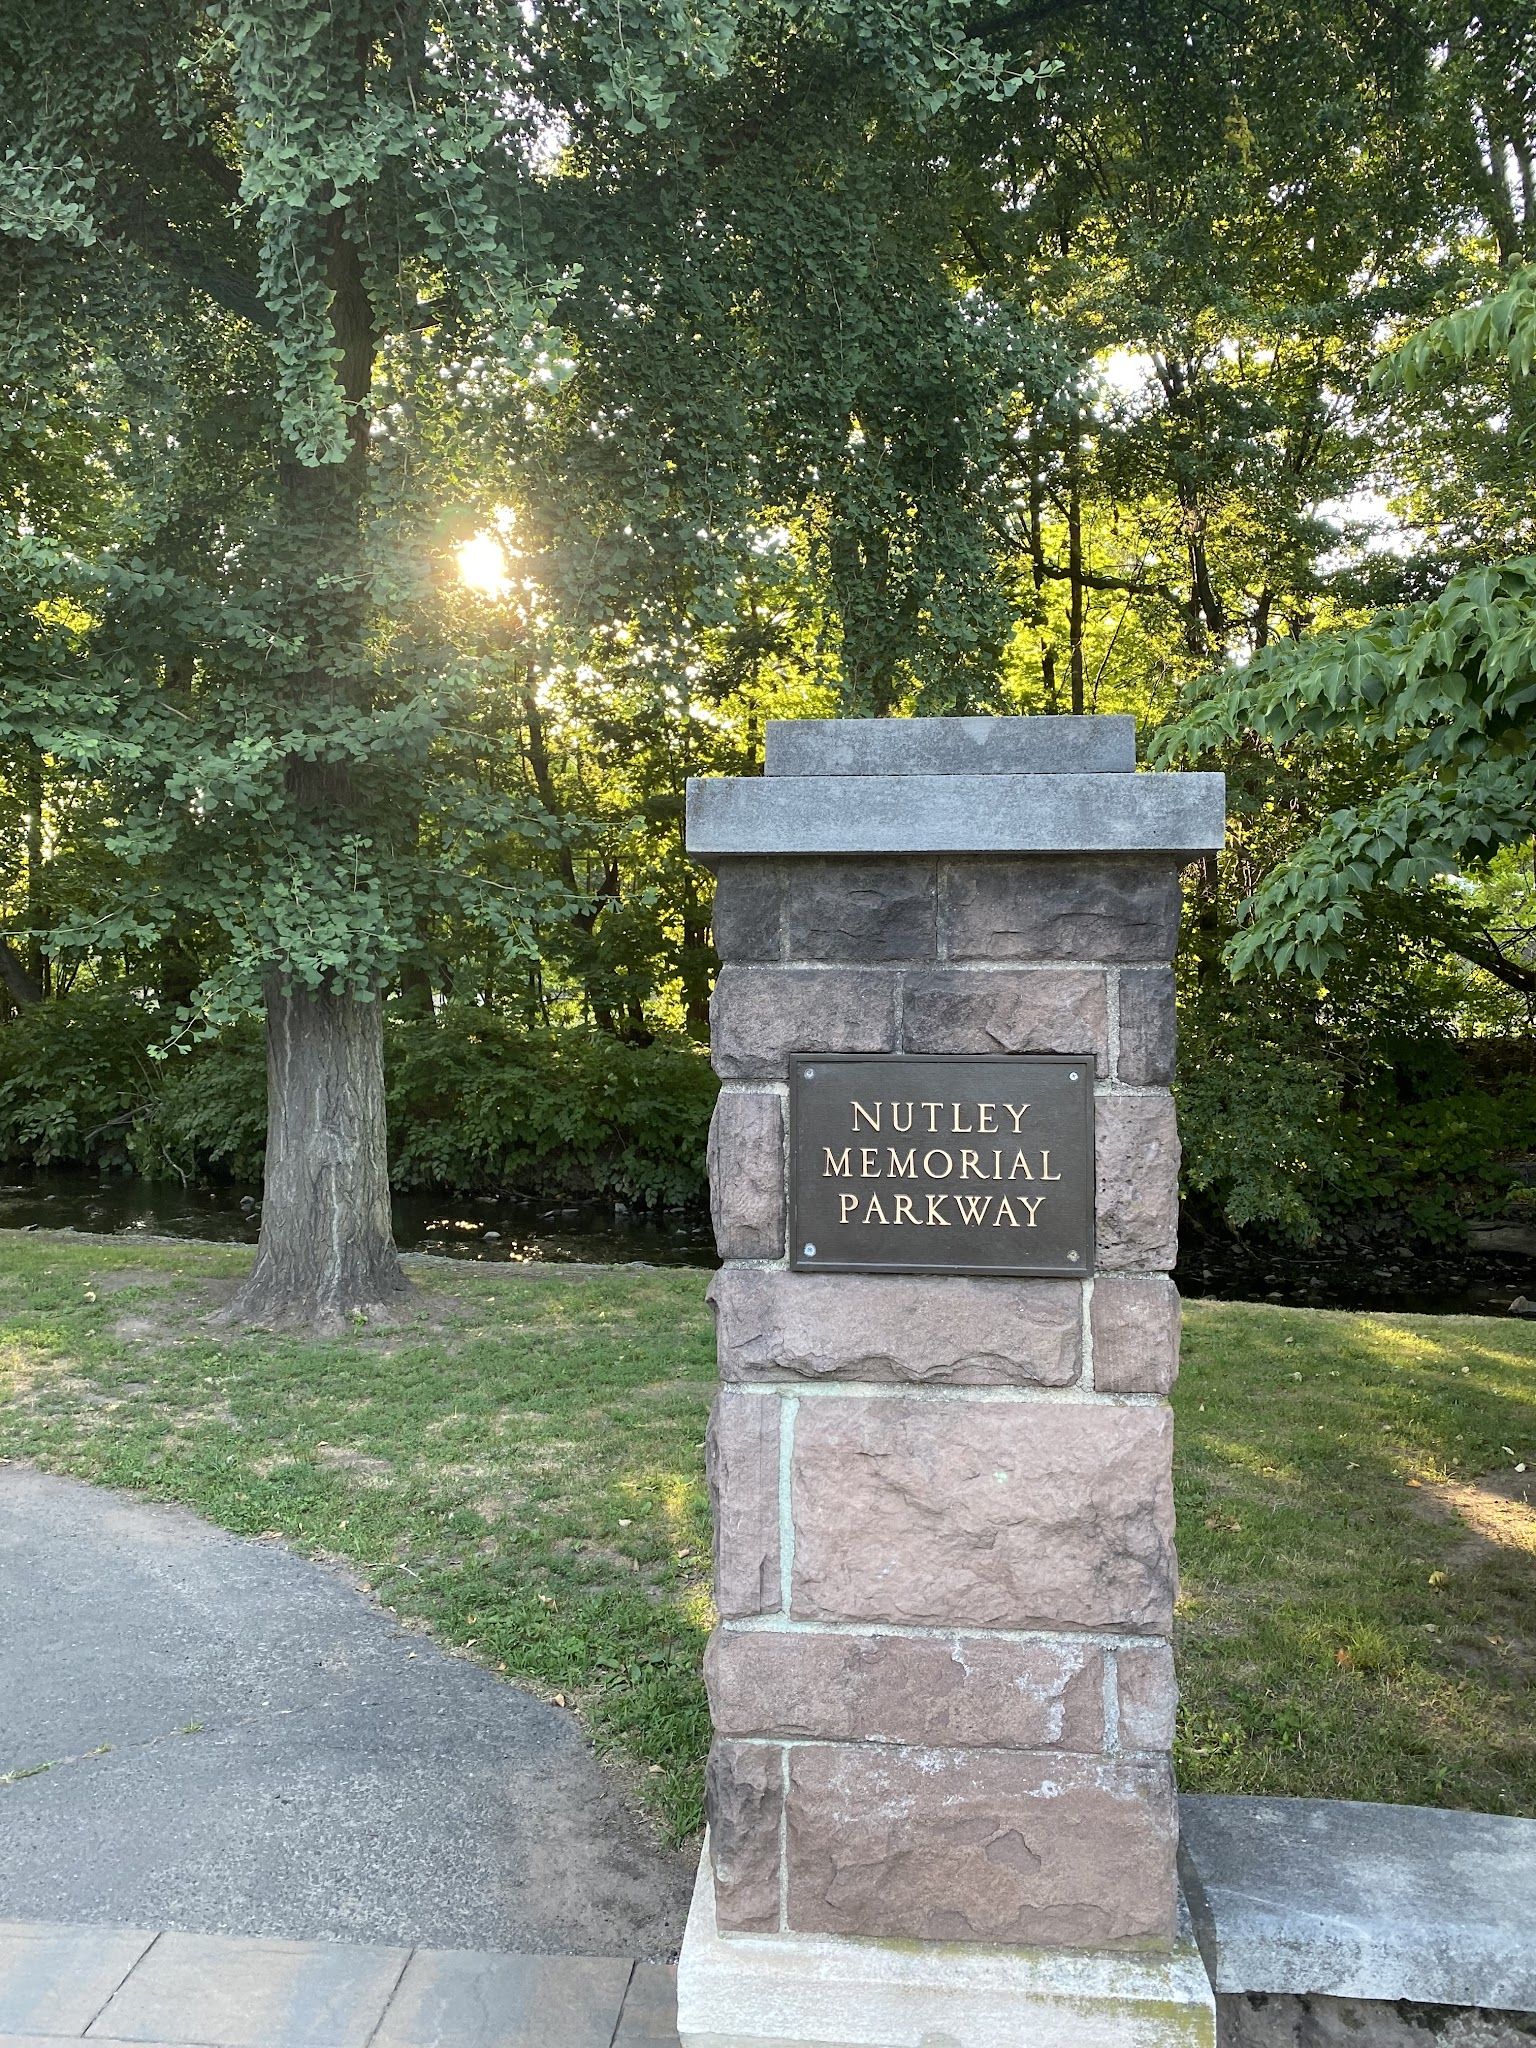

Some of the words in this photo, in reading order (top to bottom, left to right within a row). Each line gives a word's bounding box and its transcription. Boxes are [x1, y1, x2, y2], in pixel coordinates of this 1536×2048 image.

[849, 1100, 1032, 1133] NUTLEY
[821, 1146, 1062, 1181] MEMORIAL
[838, 1191, 1046, 1227] PARKWAY
